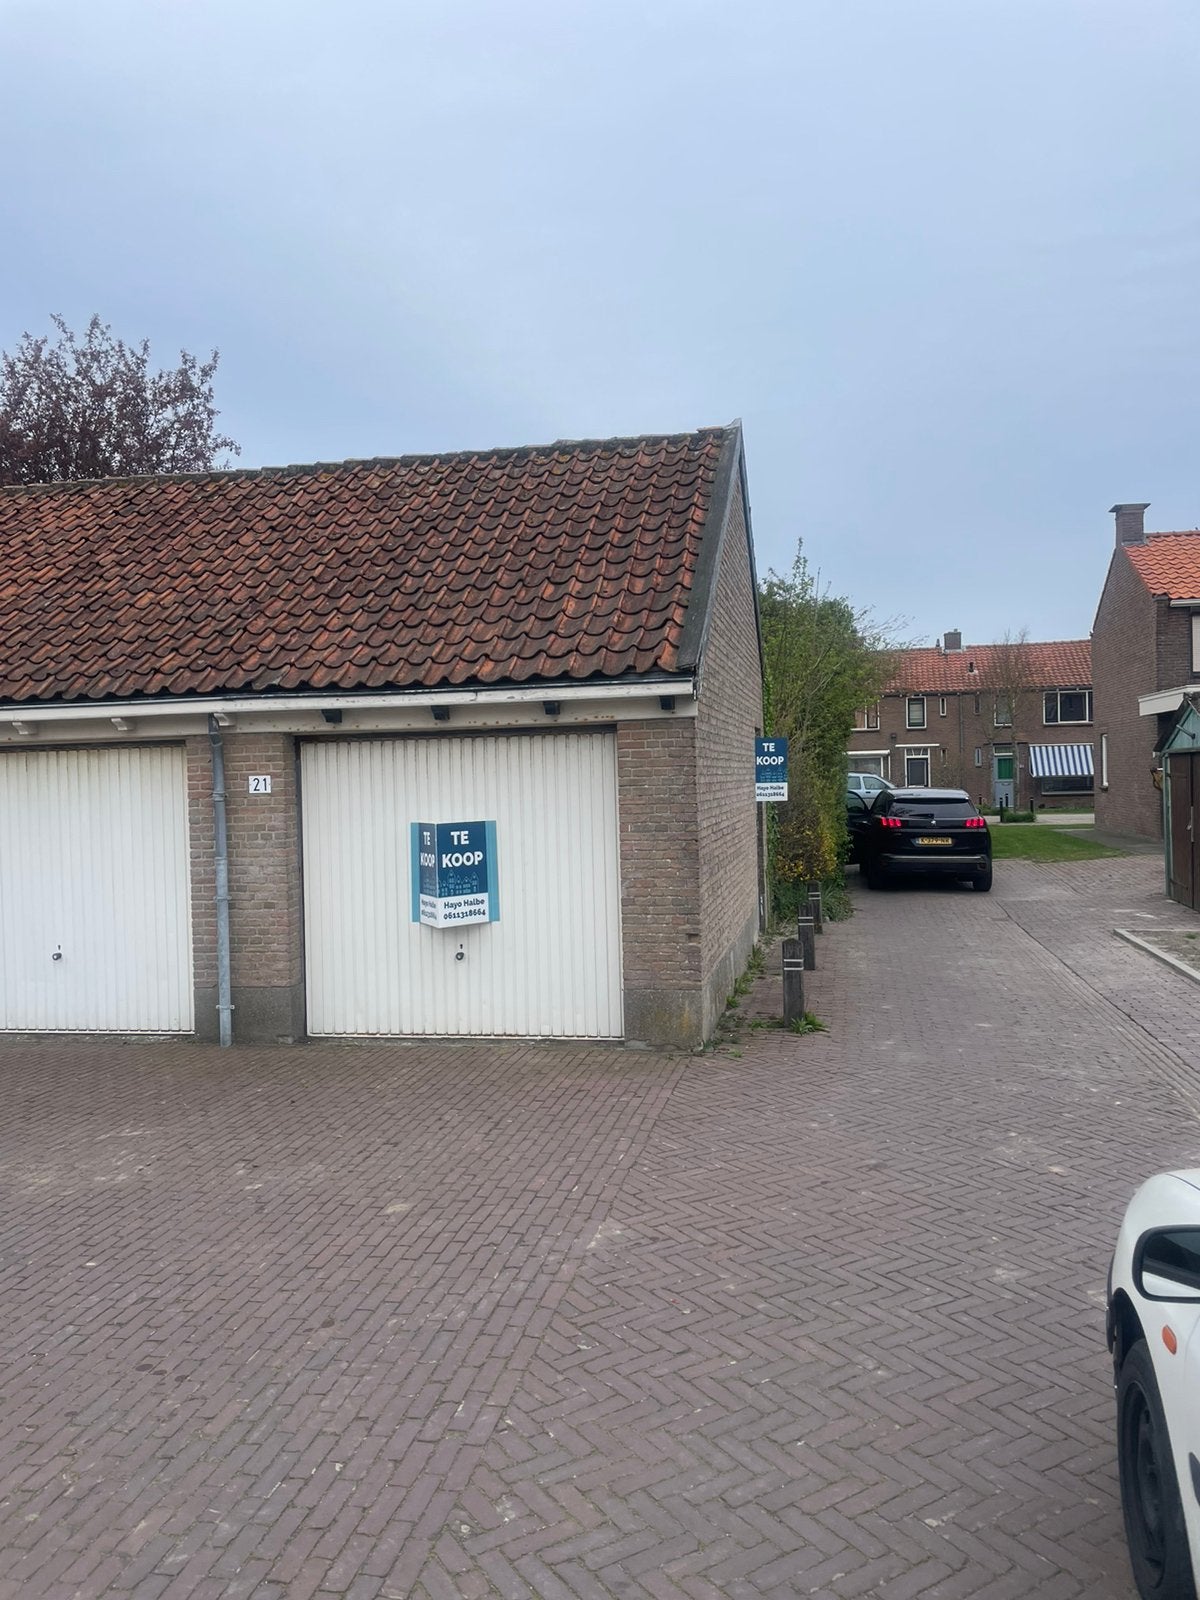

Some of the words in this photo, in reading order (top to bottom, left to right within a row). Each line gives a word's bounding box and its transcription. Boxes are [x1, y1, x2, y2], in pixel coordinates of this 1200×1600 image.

[762, 742, 775, 752] TE
[756, 756, 784, 766] KOOP
[253, 777, 267, 791] 21
[423, 831, 431, 846] TE
[450, 830, 470, 845] TE
[420, 852, 435, 868] KOOP
[442, 851, 484, 868] KOOP
[443, 901, 462, 910] Hayo
[463, 898, 485, 907] Halbe
[443, 908, 486, 920] 0611318664
